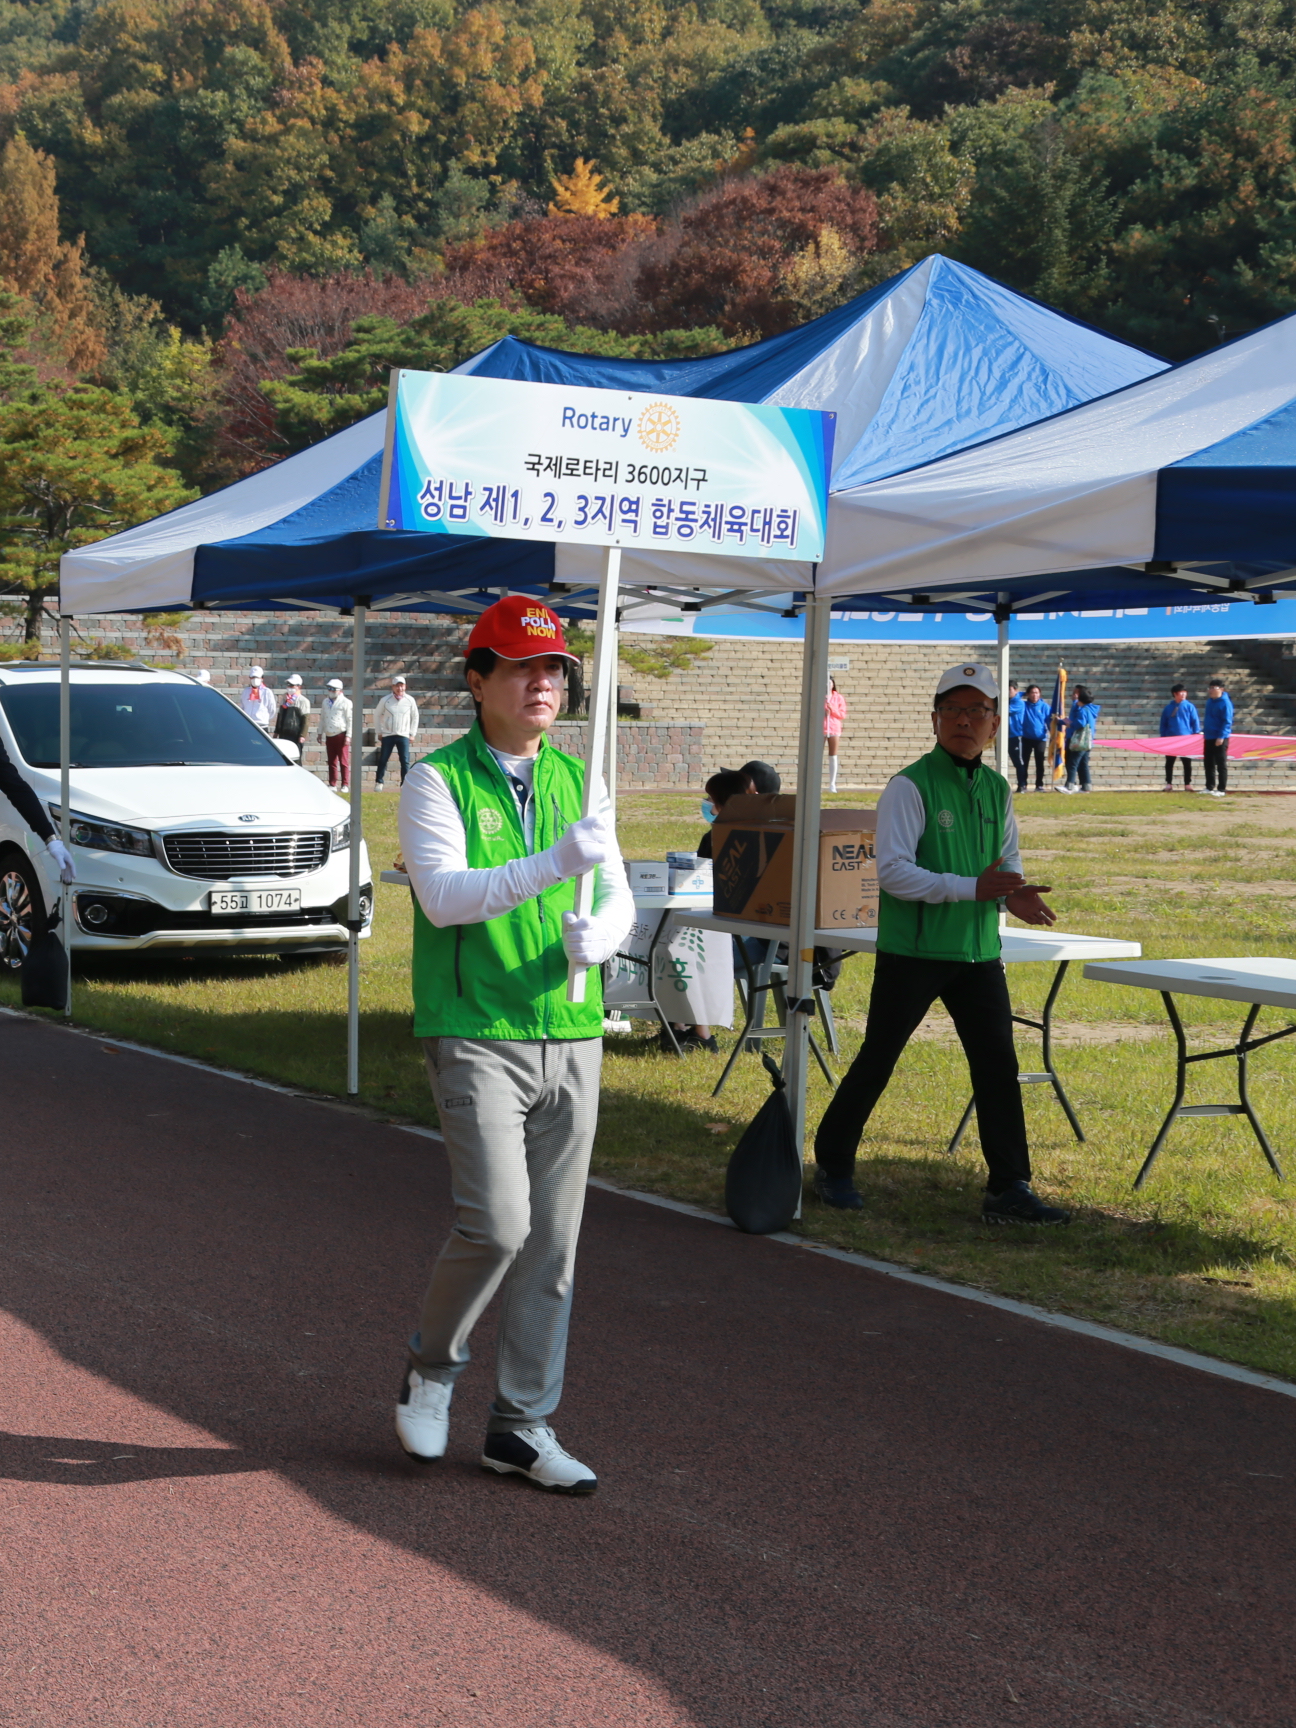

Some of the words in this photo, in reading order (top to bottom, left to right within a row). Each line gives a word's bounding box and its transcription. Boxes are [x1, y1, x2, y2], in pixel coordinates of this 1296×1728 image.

[561, 406, 633, 437] Rotary
[524, 453, 619, 484] 국제로타리
[625, 462, 709, 491] 3600지구
[420, 478, 473, 520] 성남
[573, 494, 641, 534] 3지역
[651, 497, 798, 547] 합동체육대회
[527, 626, 556, 640] NOW
[832, 844, 876, 861] NEAL
[832, 861, 862, 872] CAST
[220, 895, 249, 910] 55고
[256, 893, 293, 909] 1074
